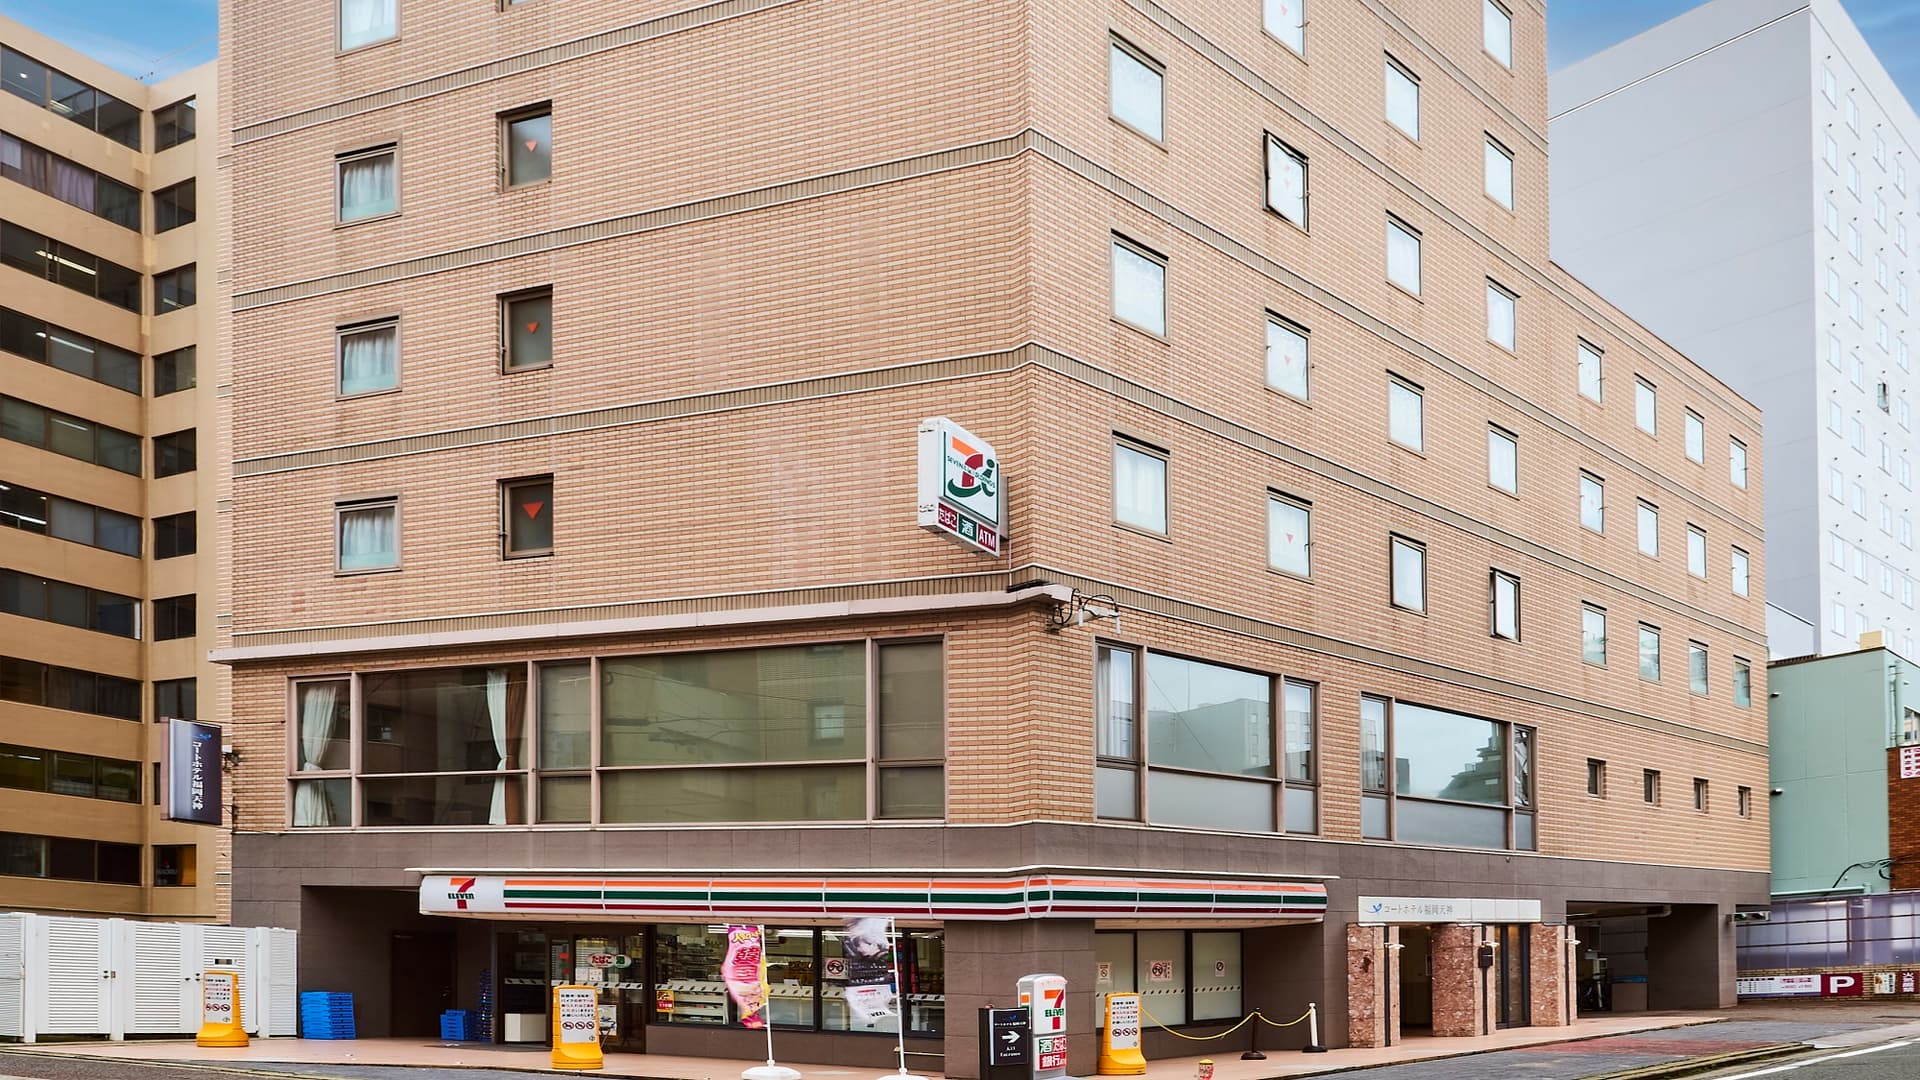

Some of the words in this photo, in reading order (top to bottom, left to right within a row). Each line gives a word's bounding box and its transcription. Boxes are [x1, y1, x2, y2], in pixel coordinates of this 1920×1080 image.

[939, 508, 957, 528] たばこ
[962, 519, 974, 537] 酒
[979, 529, 995, 549] ATM
[1829, 976, 1855, 994] P
[1040, 1039, 1053, 1054] 酒
[1042, 1055, 1061, 1068] 銀行
